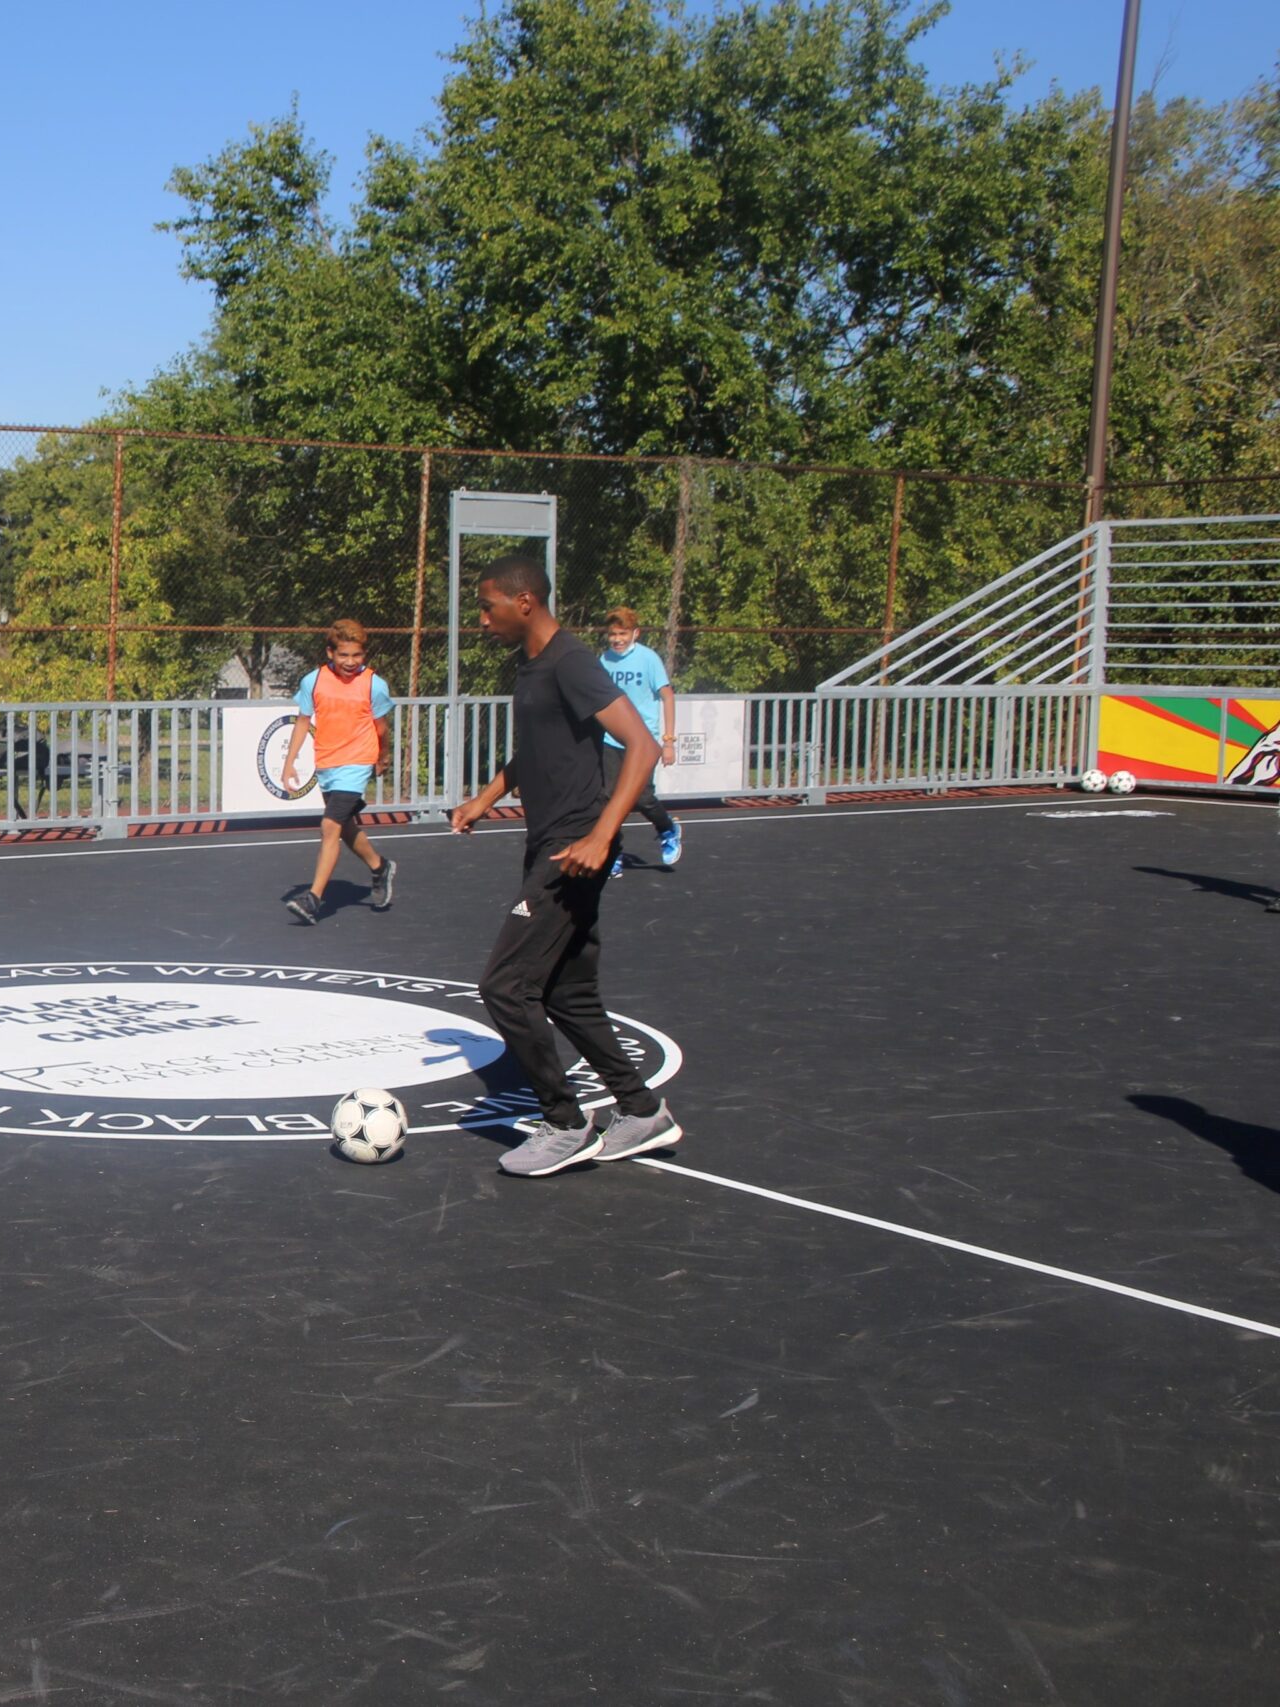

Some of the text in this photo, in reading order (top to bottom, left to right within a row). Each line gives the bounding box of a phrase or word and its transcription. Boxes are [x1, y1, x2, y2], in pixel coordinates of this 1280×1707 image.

[153, 966, 446, 993] WOMENS
[37, 1015, 260, 1042] CHANGE
[75, 1015, 156, 1028] FOR
[61, 1034, 493, 1088] PLAYER COLLECTIVE
[78, 1032, 426, 1075] BLACK WOMEN'S
[28, 1108, 330, 1132] BLACK
